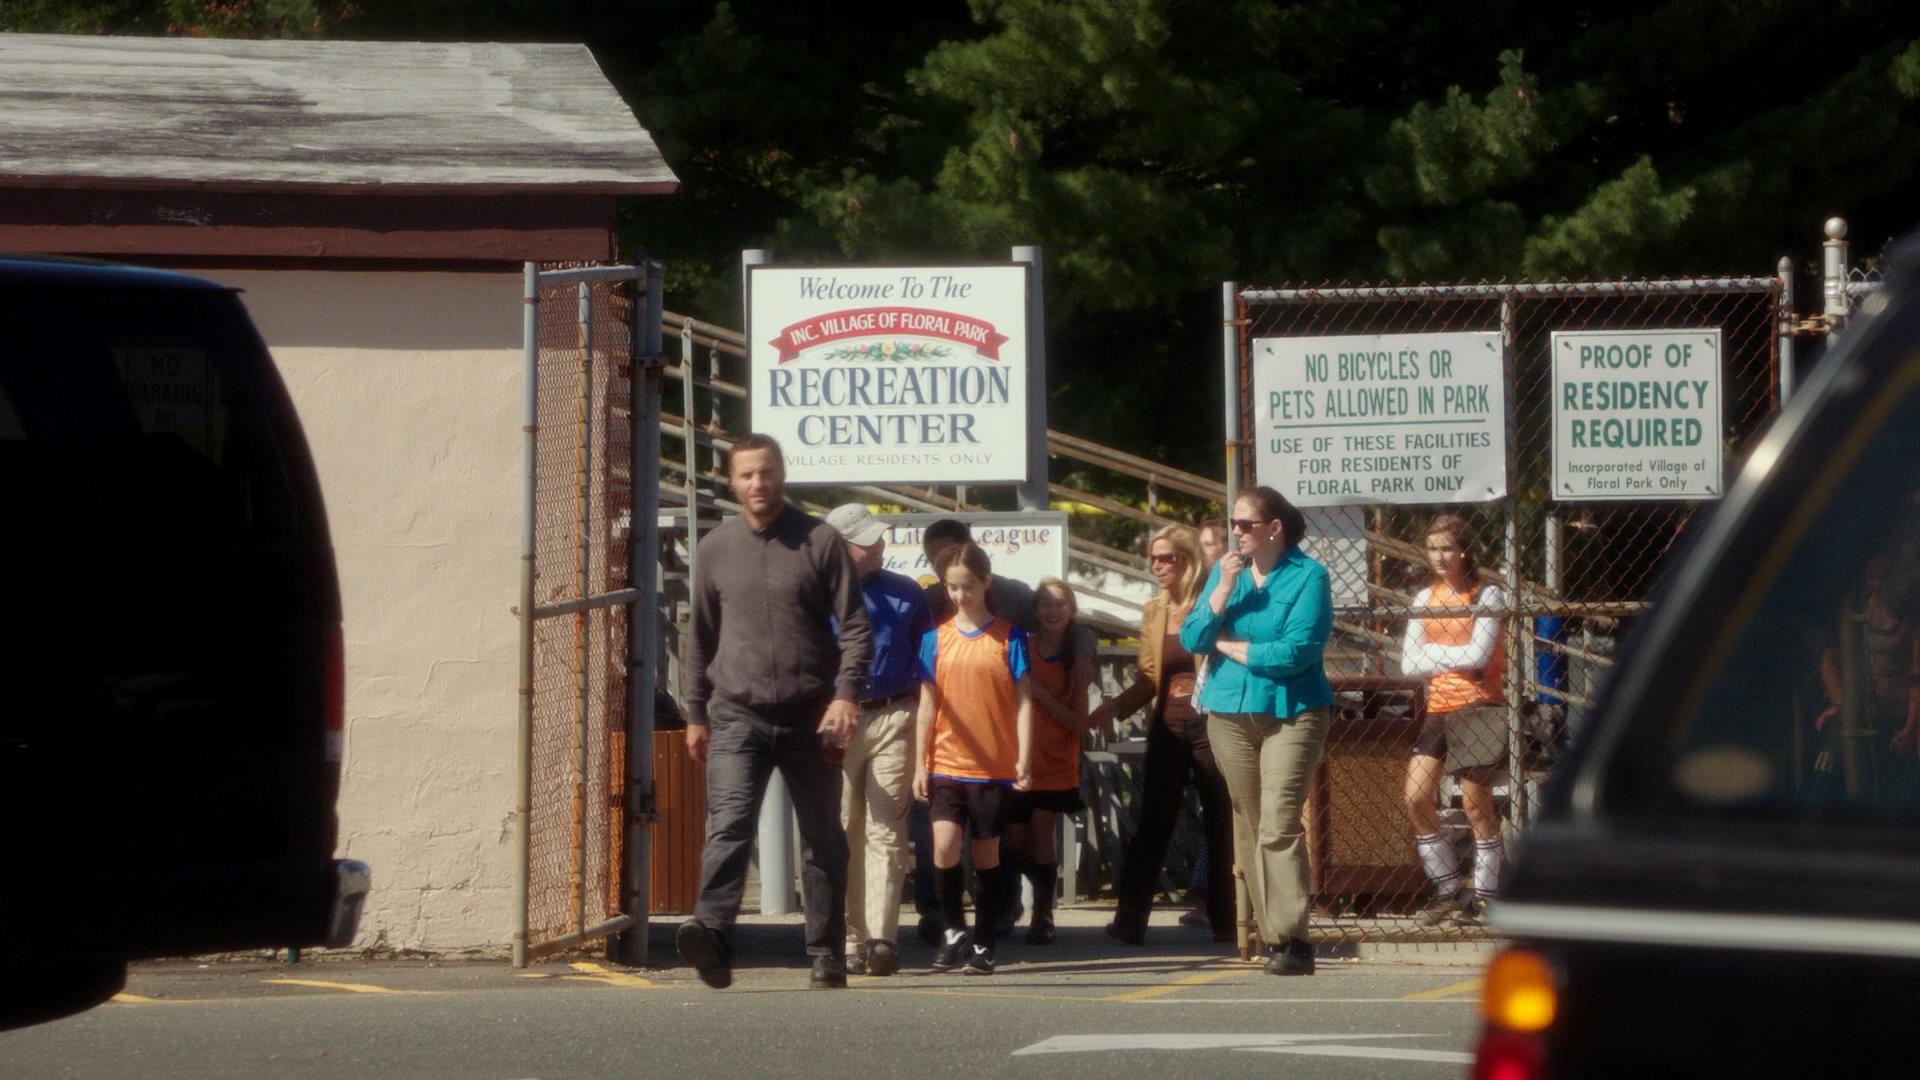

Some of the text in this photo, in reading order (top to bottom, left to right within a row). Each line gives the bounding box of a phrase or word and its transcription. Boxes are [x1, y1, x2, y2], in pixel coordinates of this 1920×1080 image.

[800, 275, 972, 300] Welcome To The
[790, 312, 989, 346] INC. VILLAGE OF FLORAL PARK
[1305, 350, 1453, 383] NO BICYCLES OR
[1580, 343, 1692, 369] PROOF OF
[768, 366, 1012, 408] RECREATION
[1563, 380, 1709, 411] RESIDENCY
[1269, 384, 1490, 420] PETS ALLOWED IN PARK
[797, 413, 981, 447] CENTER
[1571, 418, 1703, 448] REQUIRED
[1271, 432, 1491, 454] USE OF THESE FACILITIES
[785, 453, 993, 466] VILLAGE RESIDENTS ONLY
[1299, 454, 1463, 474] FOR RESIDENTS OF
[1568, 459, 1706, 475] Incorporated Village of
[1297, 476, 1465, 496] FLORAL PARK ONLY
[1588, 476, 1687, 491] Floral Park Only
[977, 528, 1050, 553] eague
